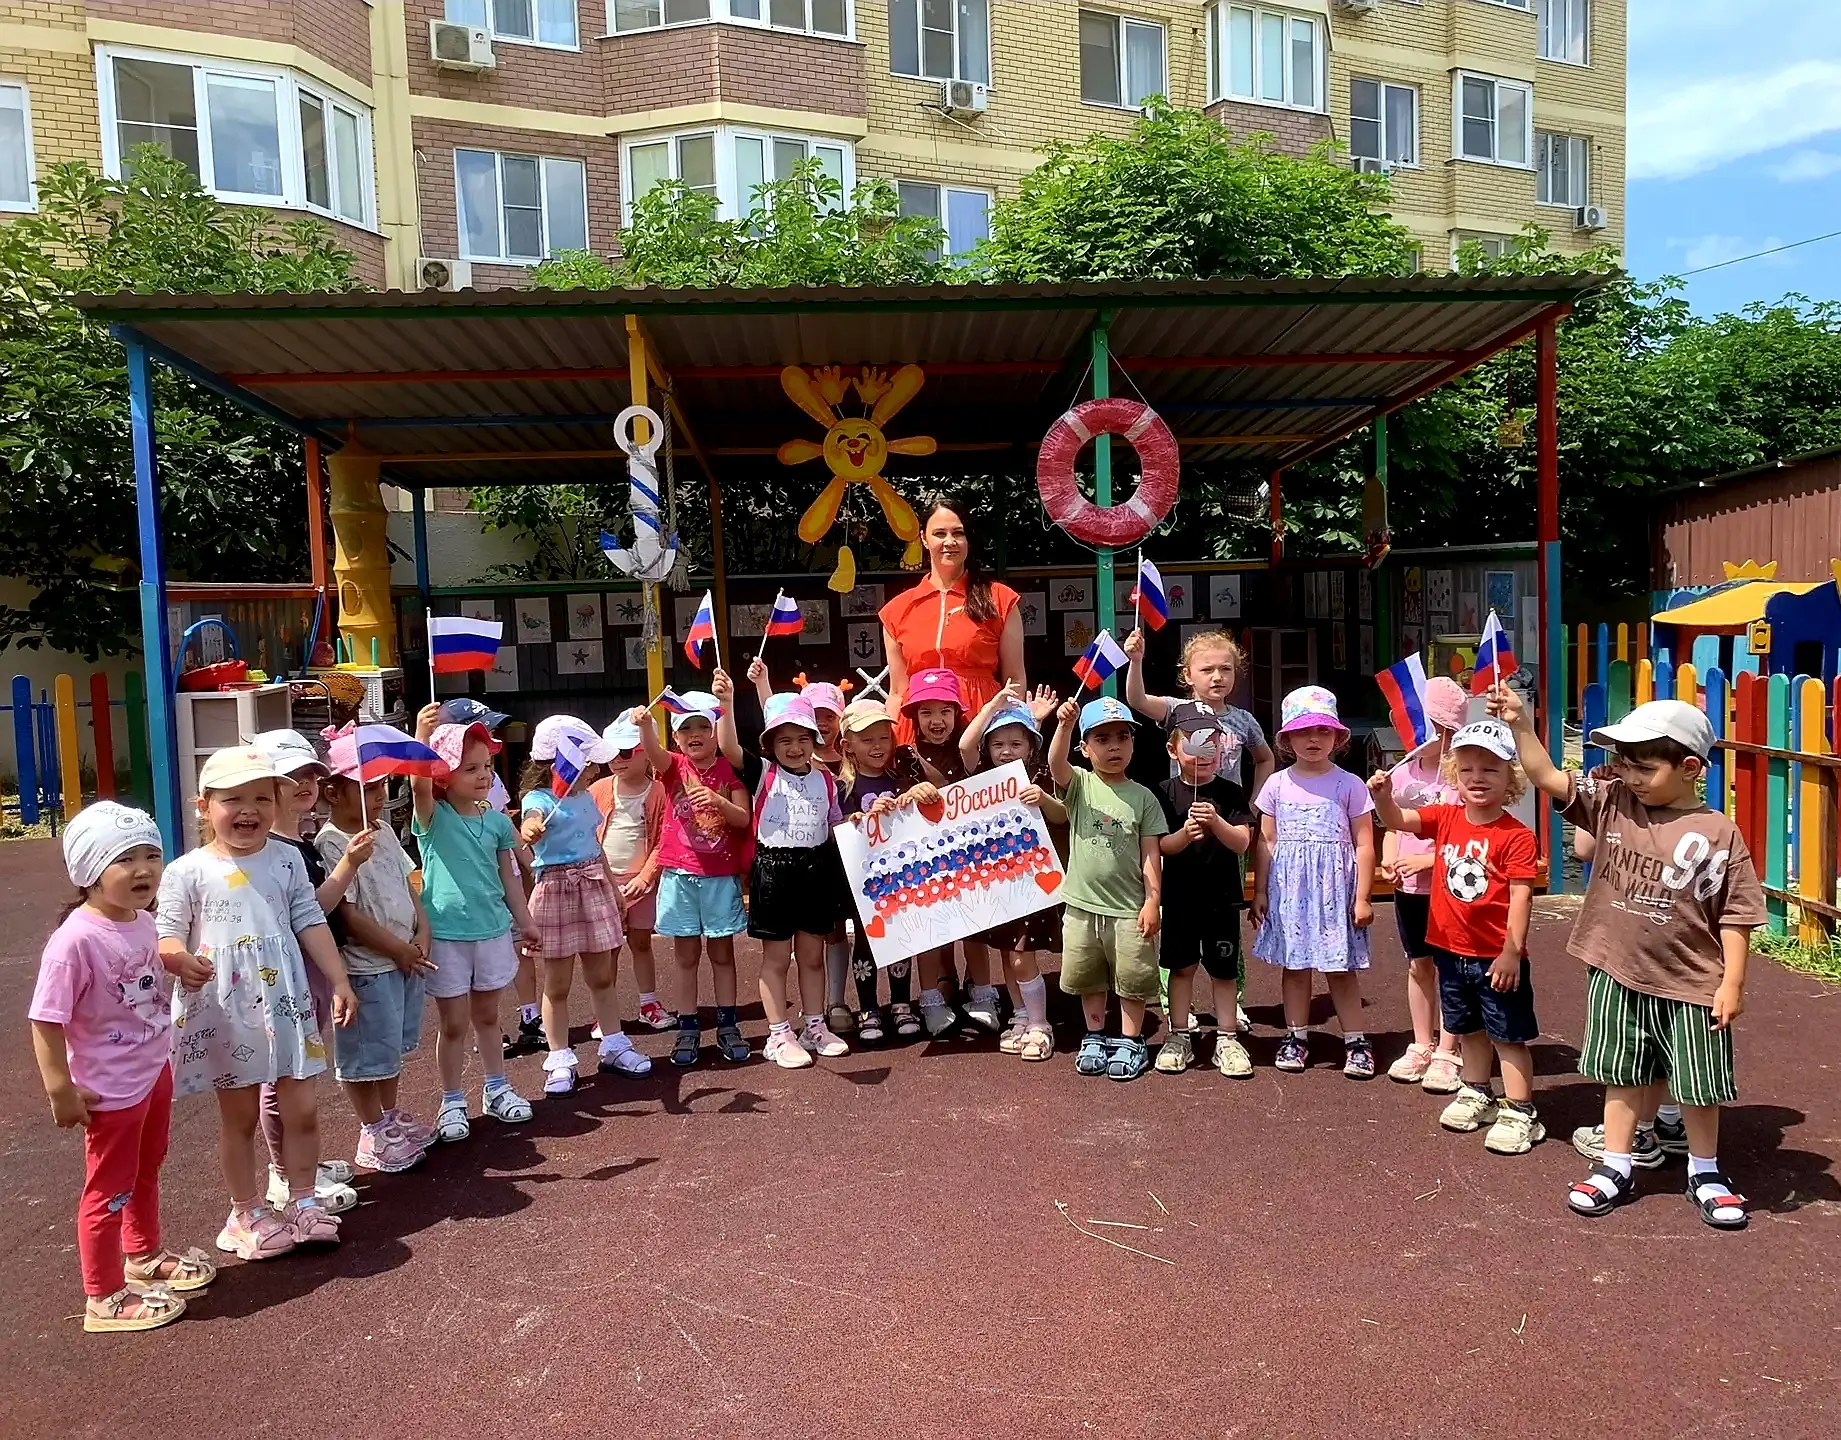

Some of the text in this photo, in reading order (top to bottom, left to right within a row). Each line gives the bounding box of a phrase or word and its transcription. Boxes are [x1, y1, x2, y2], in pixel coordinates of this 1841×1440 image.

[785, 803, 819, 816] MAIS
[866, 776, 1018, 848] Я Россию
[784, 829, 816, 841] NON
